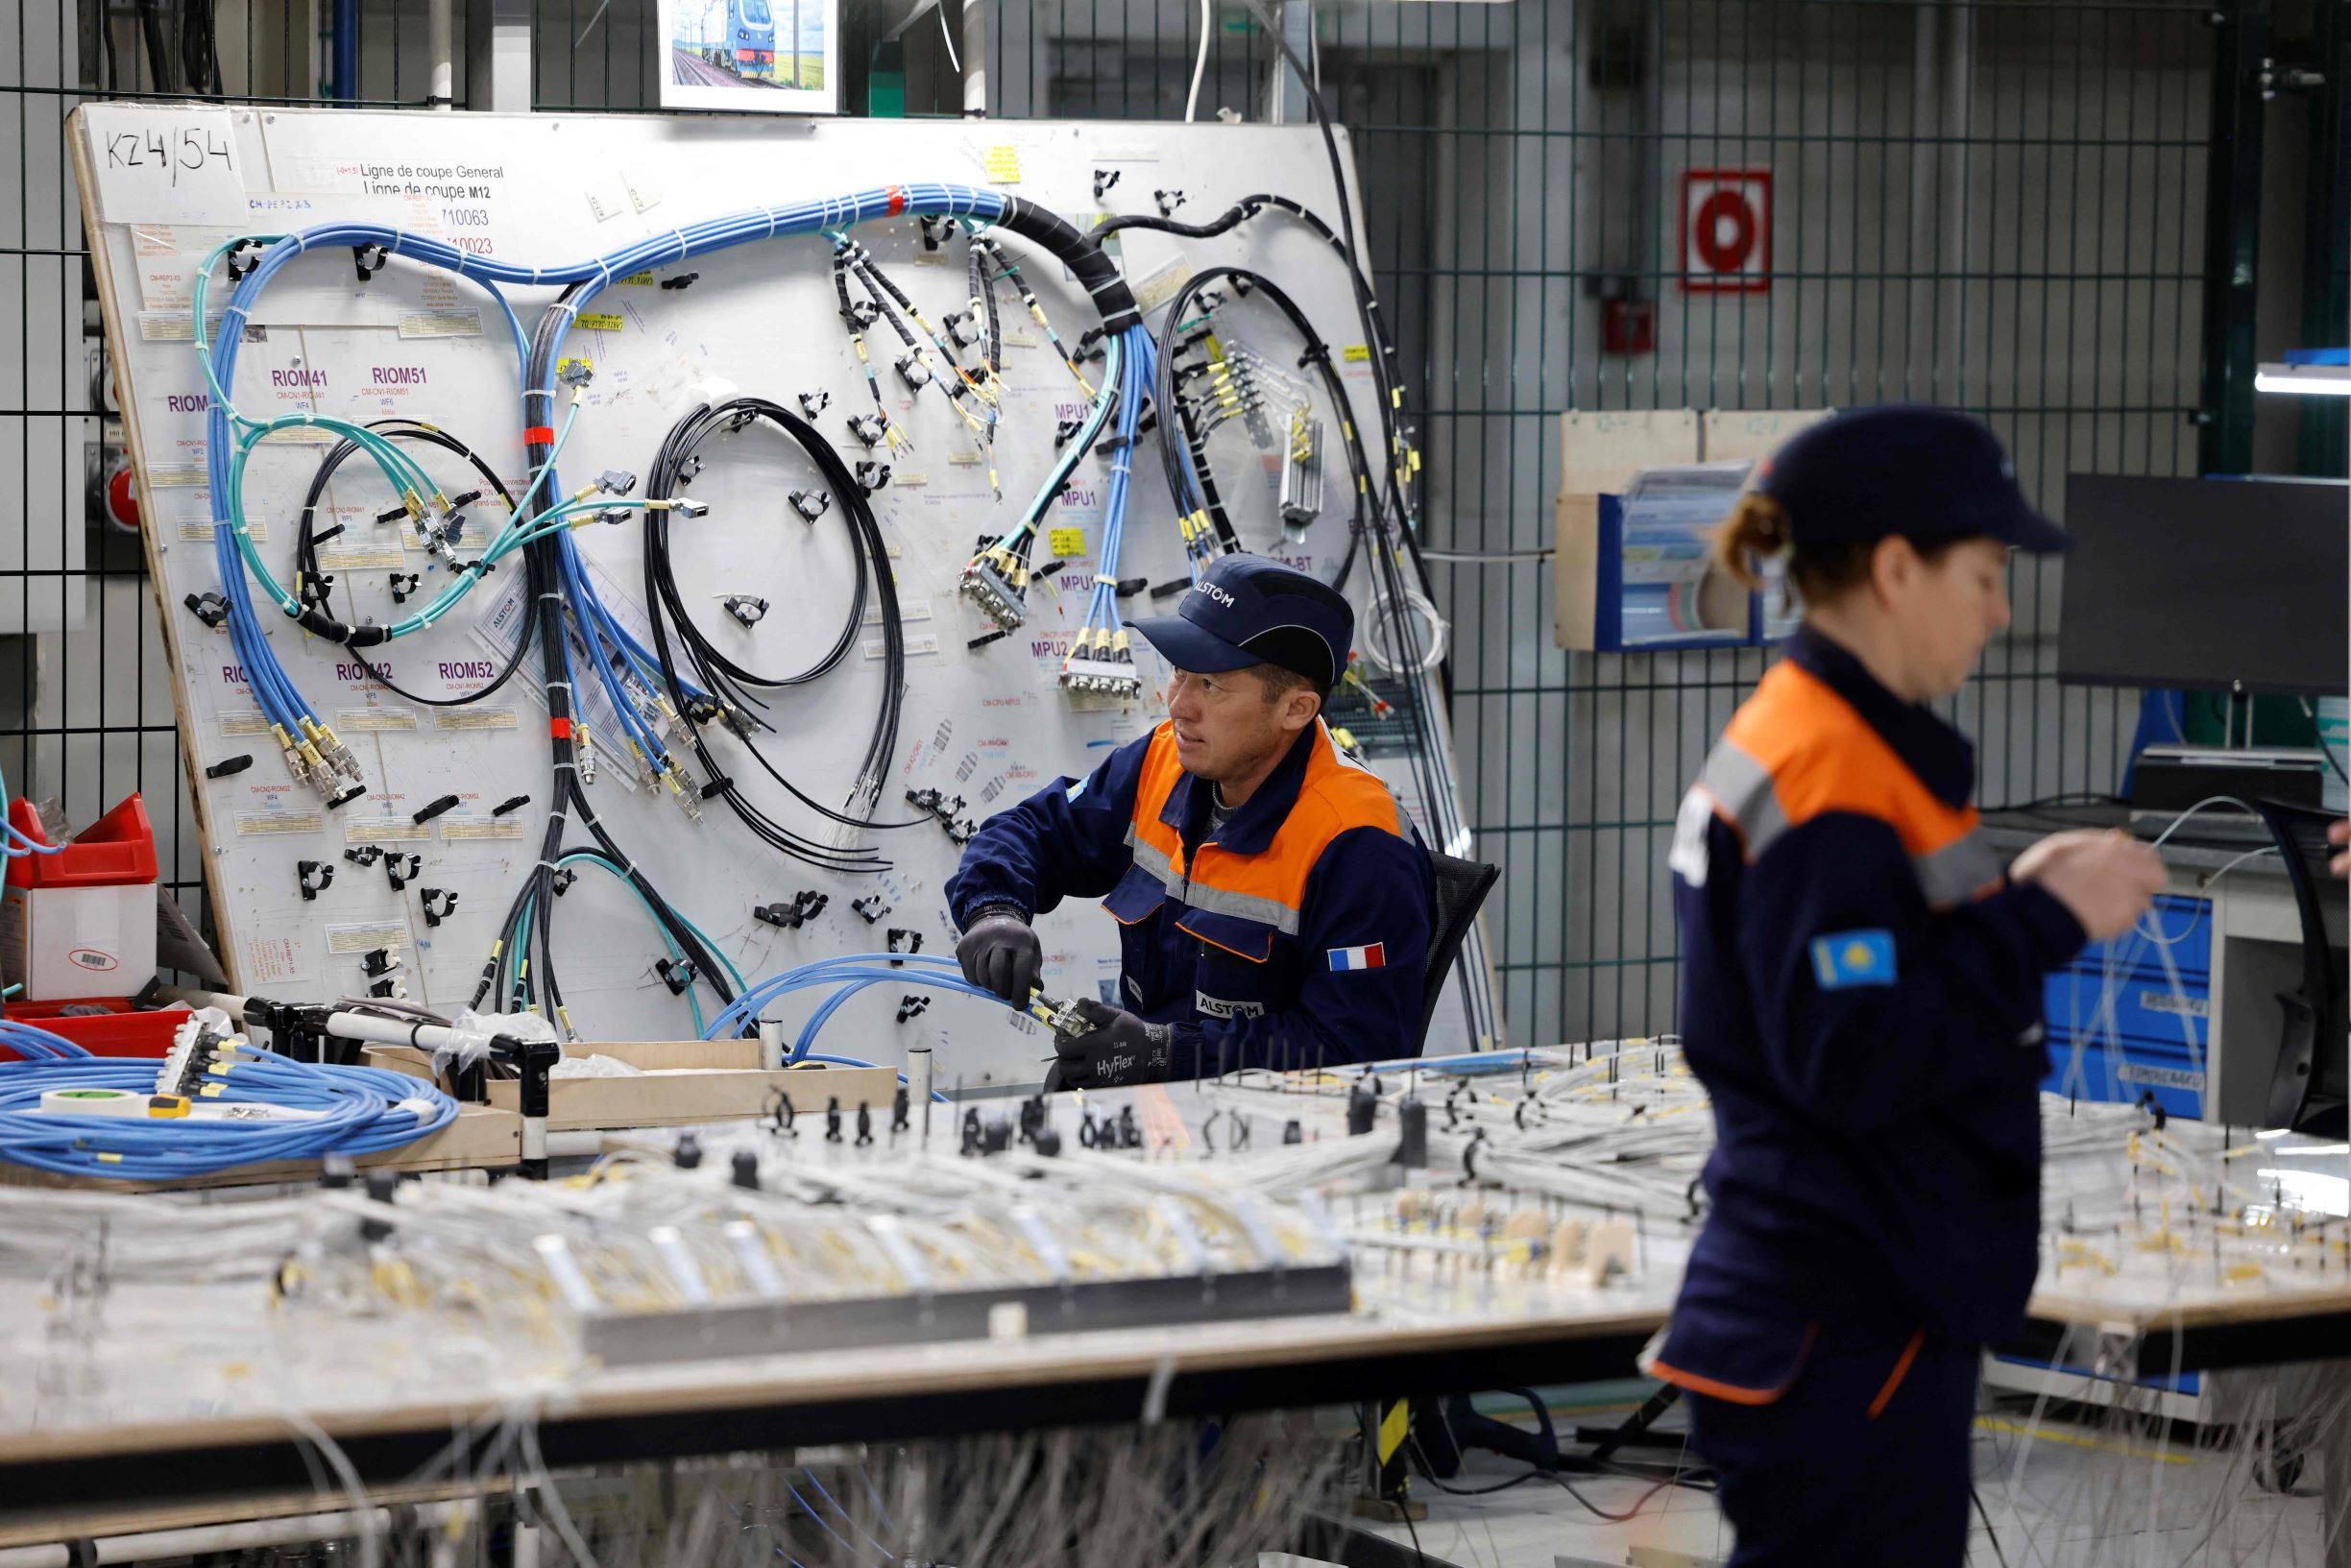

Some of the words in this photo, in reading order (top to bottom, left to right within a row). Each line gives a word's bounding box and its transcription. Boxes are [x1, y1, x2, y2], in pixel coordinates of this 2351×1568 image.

[106, 127, 232, 188] KZ4/54
[361, 163, 394, 180] Ligne
[398, 164, 413, 178] de
[416, 166, 452, 181] coupe
[456, 165, 504, 179] General
[404, 181, 422, 195] de
[425, 184, 466, 202] coupe
[469, 186, 492, 199] M12
[272, 370, 327, 387] RIOM41
[372, 367, 426, 384] RIOM51
[168, 395, 208, 412] RIOM
[1054, 404, 1090, 420] MPU1
[1061, 491, 1097, 506] MPU1
[1194, 580, 1236, 609] ALSTOM
[493, 596, 516, 628] ALSTOM
[1030, 640, 1068, 658] MPU2
[438, 661, 494, 679] RIOM52
[1097, 1054, 1133, 1078] HyFlex
